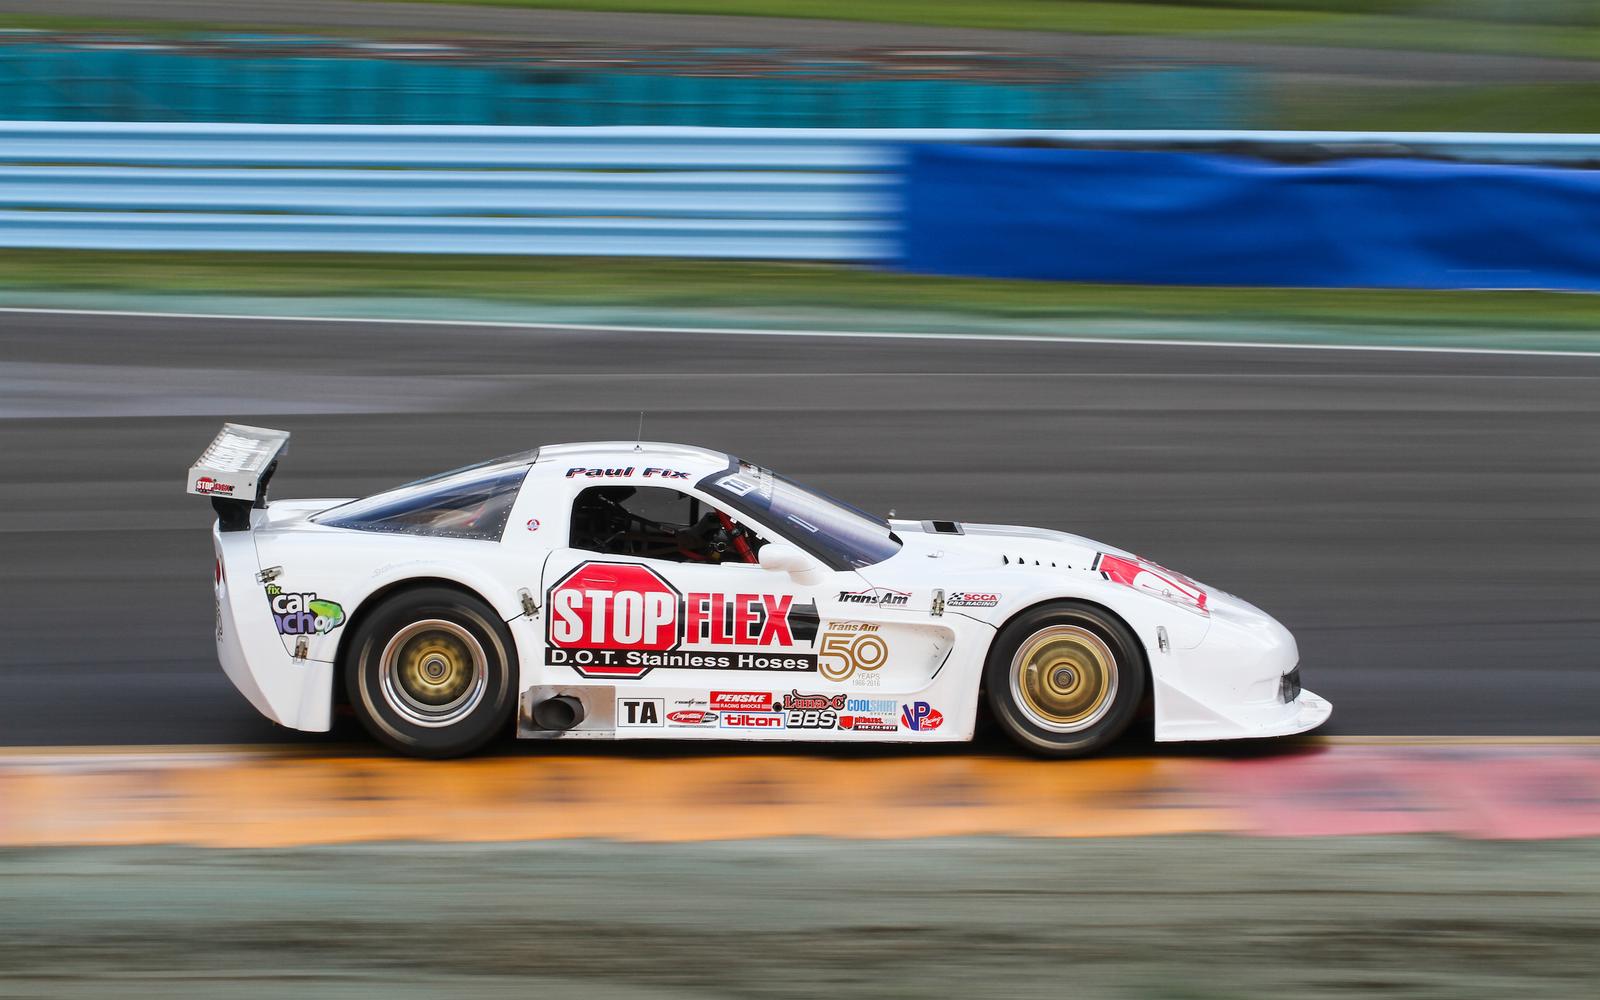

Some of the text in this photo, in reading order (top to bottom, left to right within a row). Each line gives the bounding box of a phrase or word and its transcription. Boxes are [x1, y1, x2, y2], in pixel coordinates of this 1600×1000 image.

[566, 467, 692, 479] Paul Fix
[267, 585, 281, 595] fix
[838, 591, 908, 605] Trans Am
[272, 593, 316, 614] car
[553, 588, 793, 647] STOP FLEX
[827, 622, 880, 632] Trans Am
[551, 650, 809, 669] D.O.T. Stainless Hoses
[819, 633, 888, 682] 50
[716, 694, 767, 703] PENSKE
[623, 701, 658, 724] TA
[724, 714, 781, 727] tilton
[786, 710, 837, 729] BBS
[902, 701, 931, 731] VP
